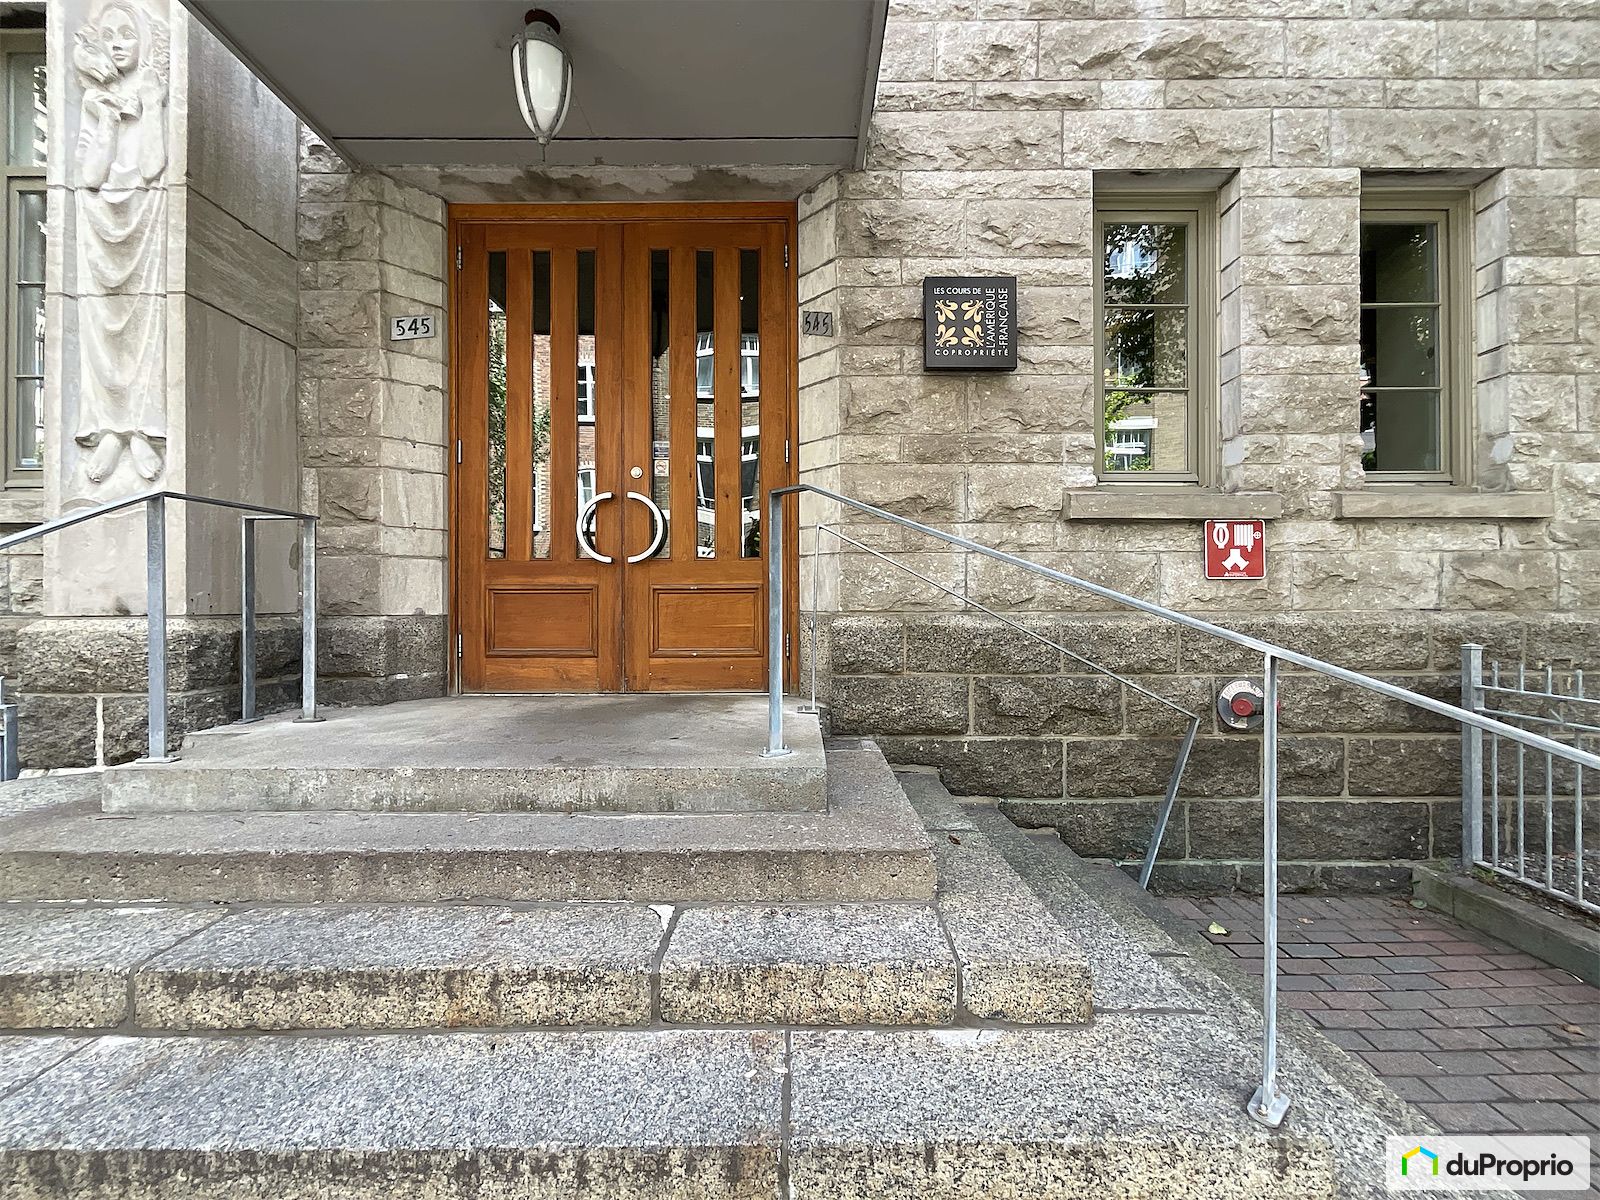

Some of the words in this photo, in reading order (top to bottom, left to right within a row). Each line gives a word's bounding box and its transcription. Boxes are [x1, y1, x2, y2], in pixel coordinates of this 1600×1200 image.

[934, 287, 945, 295] LES
[946, 287, 971, 295] COURS
[972, 287, 982, 295] DE
[396, 318, 430, 336] 545
[803, 311, 829, 335] 545
